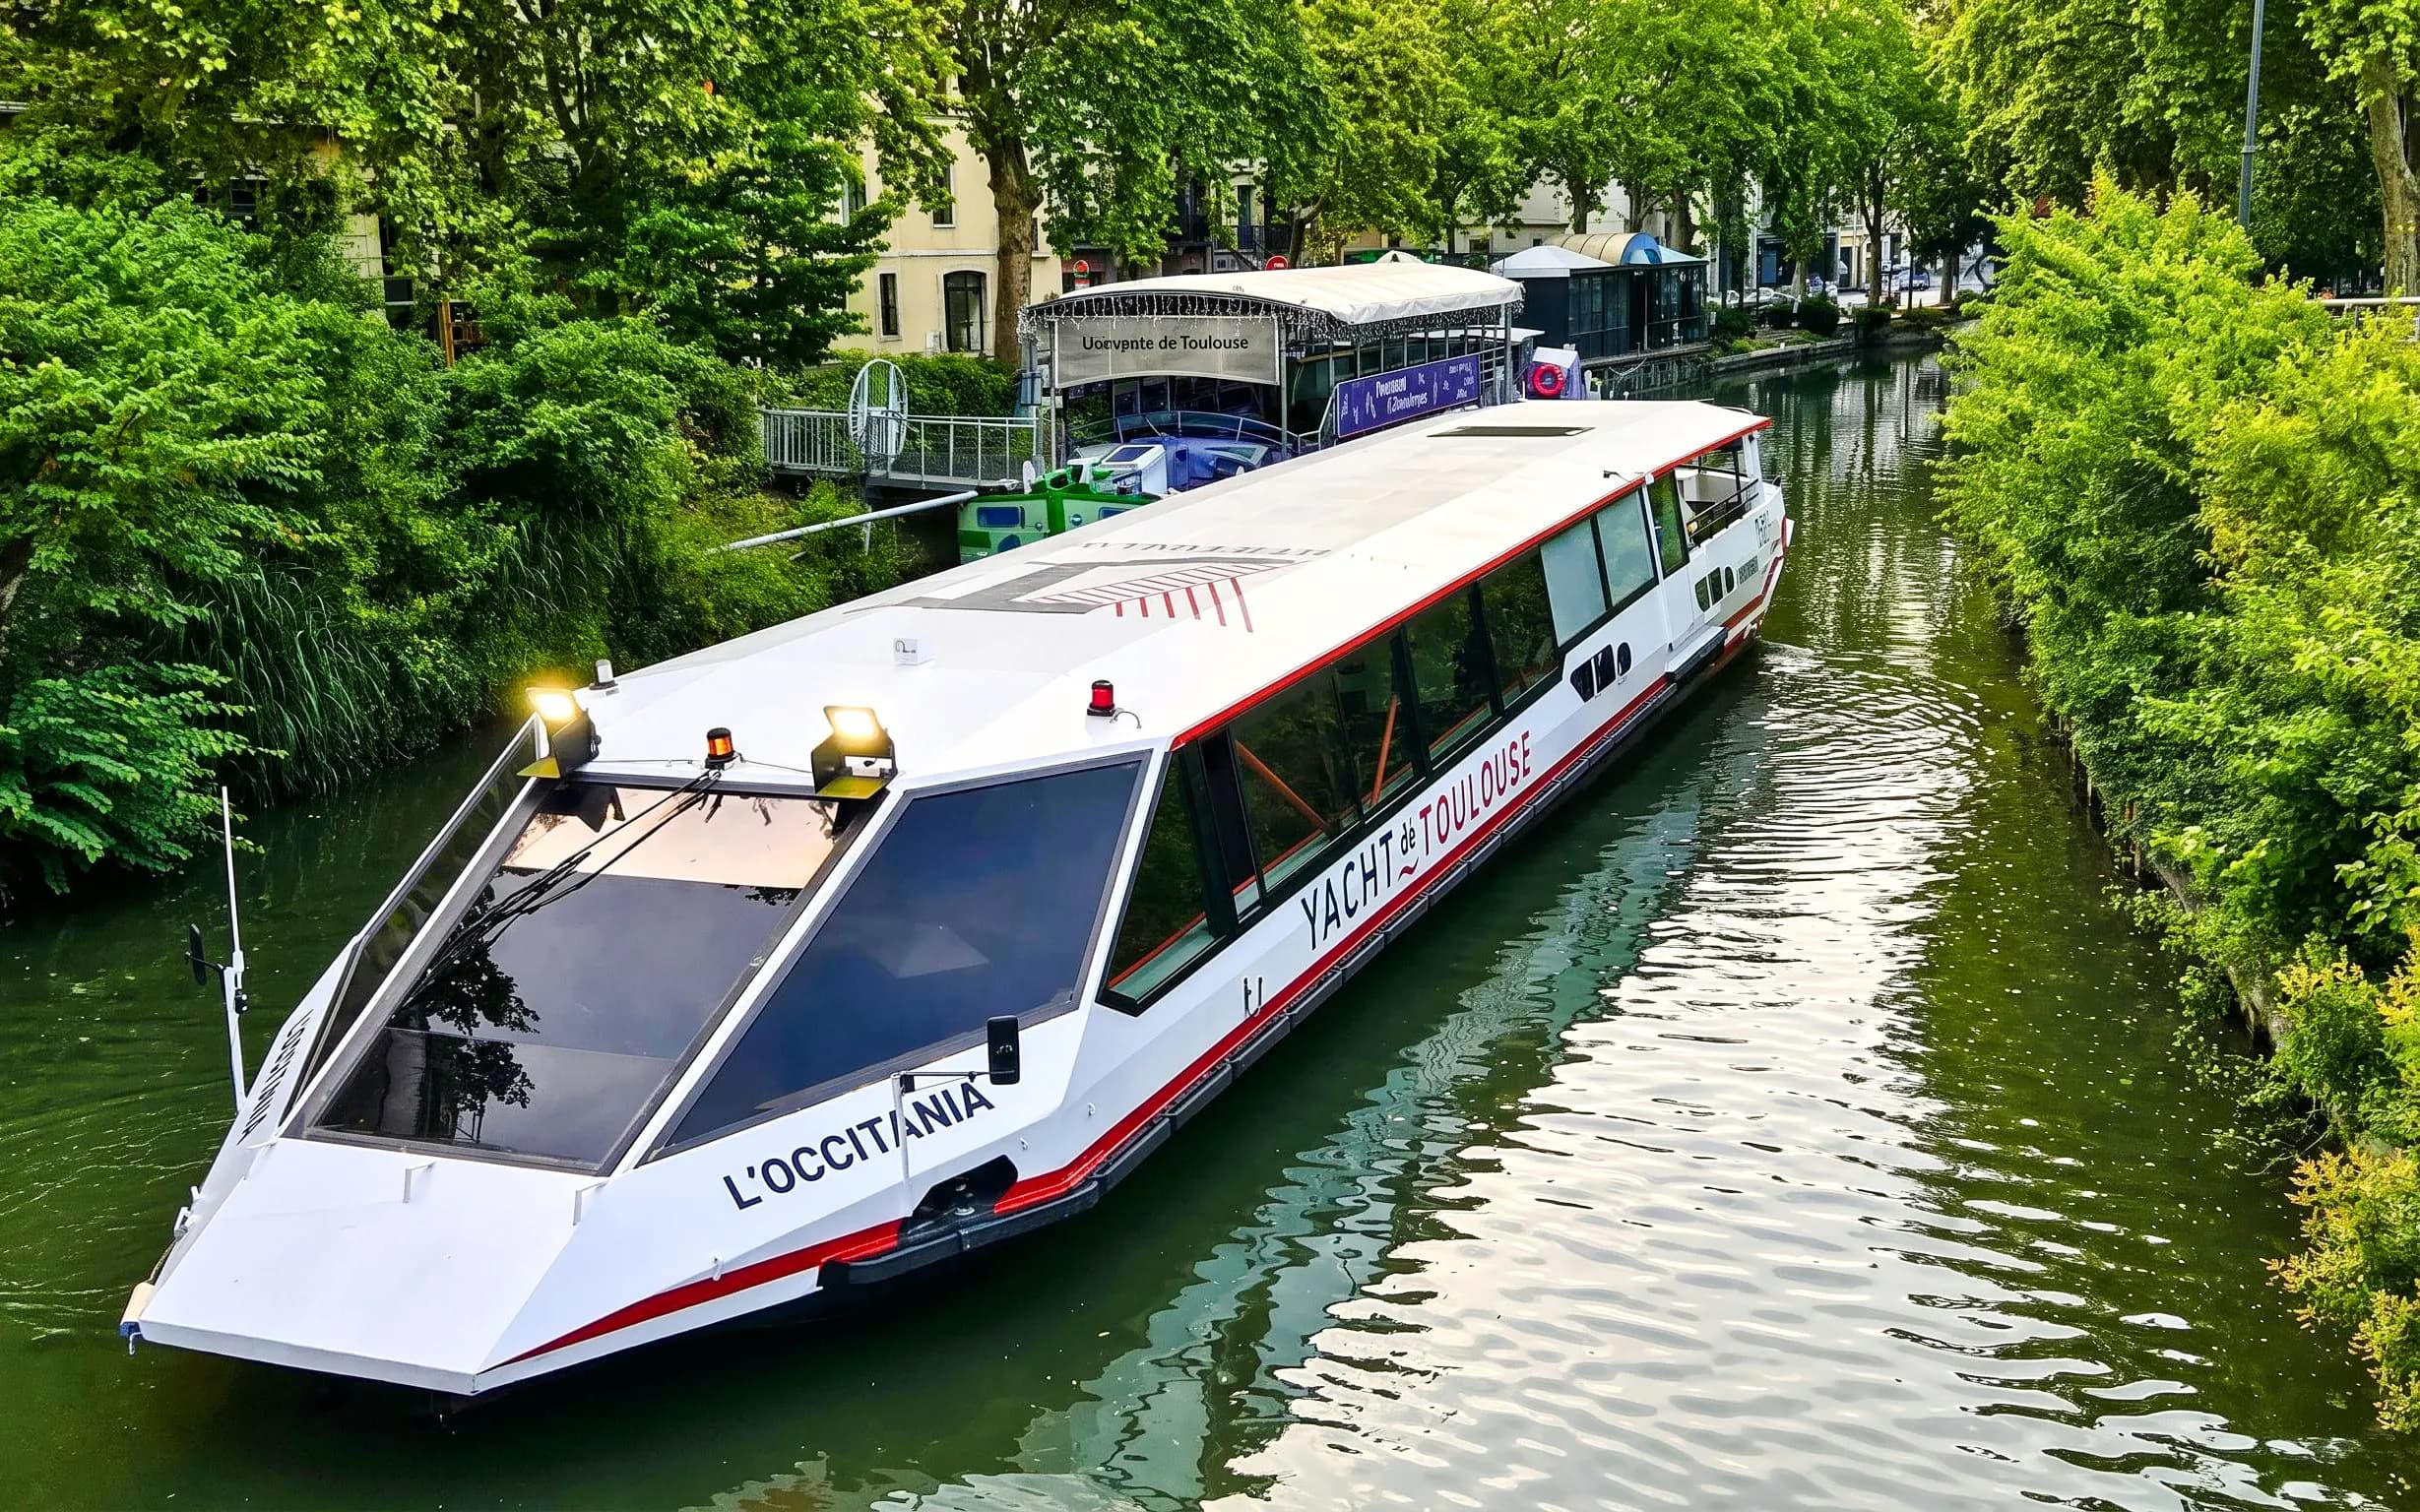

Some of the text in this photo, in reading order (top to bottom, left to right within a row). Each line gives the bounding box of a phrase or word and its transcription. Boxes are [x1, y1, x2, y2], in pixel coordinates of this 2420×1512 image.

[1158, 336, 1178, 349] de
[1180, 335, 1248, 349] Toulouse
[1301, 830, 1393, 951] YACHT
[1419, 730, 1531, 856] TOULOUSE
[723, 1082, 995, 1211] L'OCCITANIA
